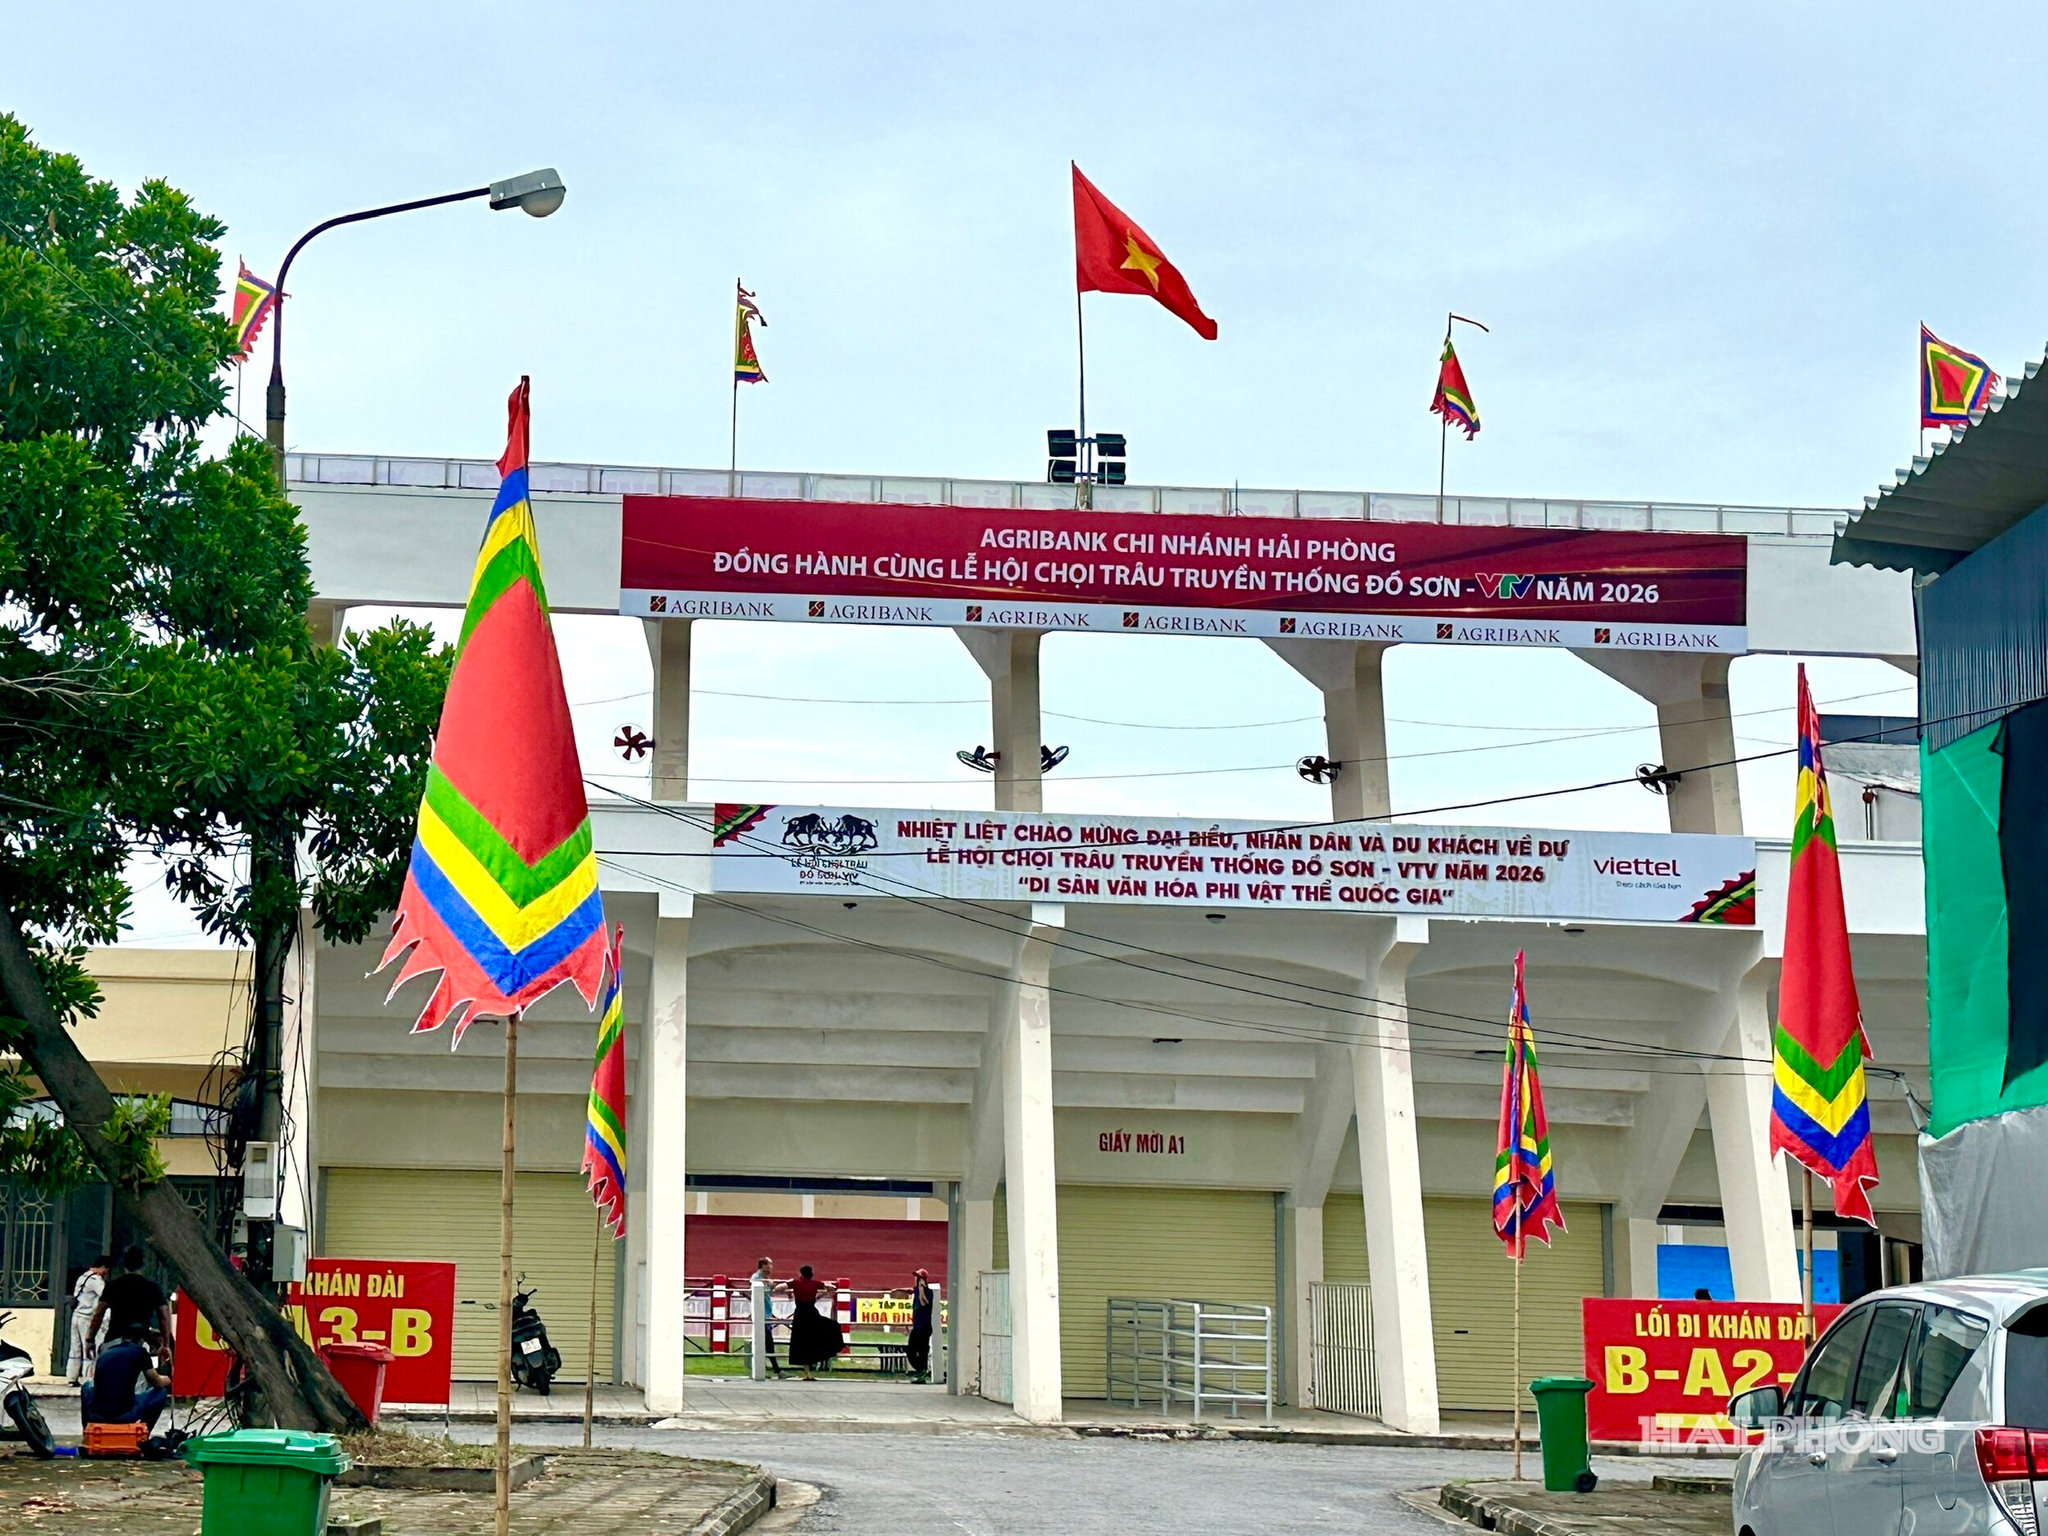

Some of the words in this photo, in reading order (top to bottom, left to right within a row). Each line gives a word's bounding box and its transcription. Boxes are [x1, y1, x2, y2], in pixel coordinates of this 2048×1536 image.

[980, 528, 1108, 552] AGRIBANK
[1113, 533, 1154, 554] CHI
[1161, 532, 1251, 557] NHÁNH
[1257, 534, 1300, 559] HẢI
[1306, 537, 1396, 562] PHÒNG
[713, 546, 789, 574] ĐỒNG
[795, 551, 868, 577] HÀNH
[873, 552, 944, 579] CÙNG
[951, 552, 978, 580] LỄ
[983, 557, 1028, 587] HỘI
[1034, 561, 1095, 589] CHỌI
[1099, 561, 1165, 587] TRÂU
[1169, 563, 1266, 590] TRUYỀN
[1271, 565, 1360, 594] THỐNG
[1409, 575, 1461, 598] SƠN
[1537, 576, 1594, 601] NĂM
[1600, 582, 1660, 604] 2026
[670, 600, 775, 616] AGRIBANK
[829, 605, 933, 621] AGRIBANK
[986, 610, 1090, 627] AGRIBANK
[1143, 616, 1247, 633] AGRIBANK
[1300, 621, 1404, 638] AGRIBANK
[1457, 627, 1562, 643] AGRIBANK
[1614, 632, 1720, 648] AGRIBANK
[897, 818, 957, 842] NHIỆT
[964, 819, 1008, 843] LIỆT
[1013, 821, 1073, 843] CHÀO
[1080, 823, 1139, 844] MỪNG
[1246, 828, 1303, 850] NHÂN
[1309, 831, 1352, 851] DÂN
[1360, 832, 1386, 853] VÀ
[1392, 837, 1421, 853] DU
[1428, 834, 1500, 856] KHÁCH
[1506, 834, 1533, 857] VỀ
[1539, 838, 1571, 862] DỰ
[957, 845, 995, 868] HỘI
[1001, 849, 1053, 870] CHỌI
[1061, 849, 1115, 870] TRÂU
[1210, 851, 1285, 875] THỐNG
[1330, 859, 1375, 878] SƠN
[1397, 861, 1439, 880] VTV
[1444, 859, 1489, 881] NĂM
[1495, 865, 1546, 882] 2026
[1593, 856, 1681, 877] viettel
[1107, 875, 1147, 897] VĂN
[1154, 877, 1199, 898] HÓA
[1206, 882, 1240, 899] PHI
[1246, 880, 1286, 904] VẬT
[1291, 878, 1333, 902] THỂ
[1338, 881, 1400, 904] QUỐC
[1099, 1127, 1132, 1153] GIẤY
[1136, 1129, 1164, 1154] MỜI
[1167, 1135, 1185, 1155] A1
[366, 1269, 405, 1298] ĐÀI
[1635, 1304, 1671, 1338] LỐI
[1677, 1313, 1701, 1338] ĐI
[1707, 1309, 1771, 1340] KHÁN
